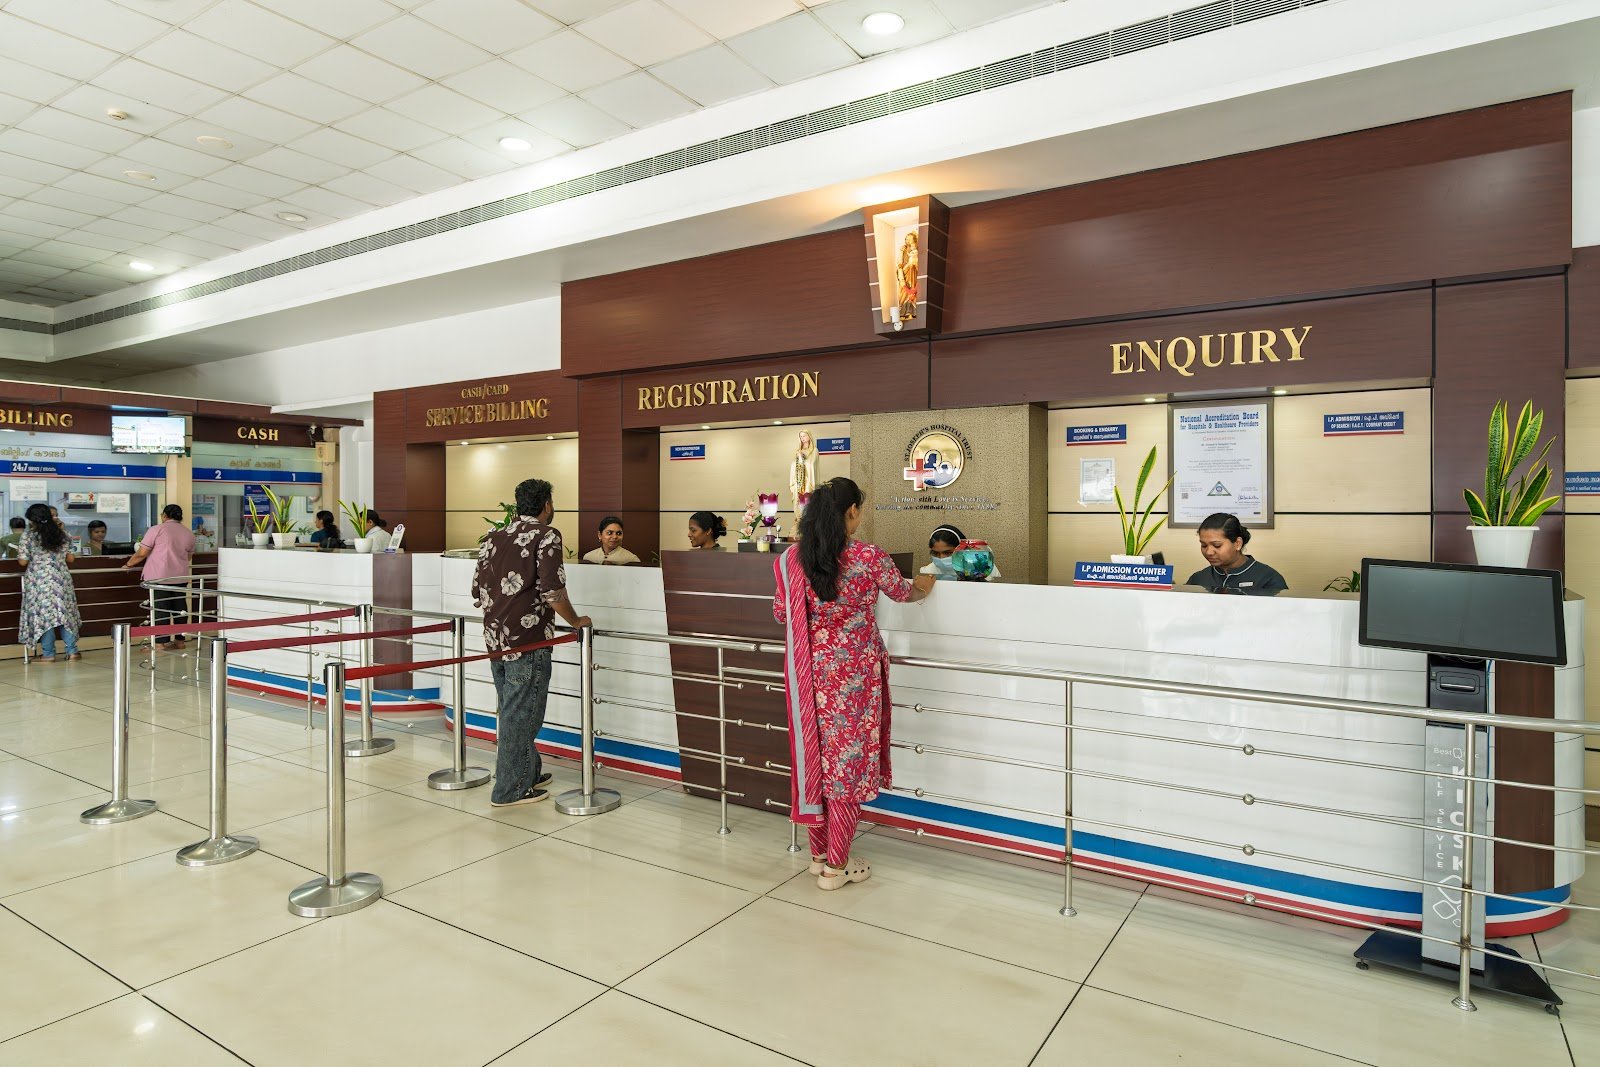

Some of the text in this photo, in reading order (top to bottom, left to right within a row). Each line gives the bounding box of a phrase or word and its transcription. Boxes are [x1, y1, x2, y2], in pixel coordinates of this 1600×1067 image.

[1110, 325, 1312, 376] ENQUIRY
[461, 383, 509, 399] CASH/CARD
[637, 371, 820, 410] REGISTRATION
[0, 408, 73, 428] BILLING
[426, 398, 548, 427] SERVICE BILLING
[1180, 412, 1259, 423] National Accreditation Board
[237, 426, 279, 441] CASH
[930, 423, 962, 439] HOSPITAL
[960, 436, 973, 461] TRUST
[122, 466, 127, 476] 1
[215, 470, 222, 480] 2
[291, 473, 296, 482] 1
[1092, 566, 1131, 574] ADMISSION
[1133, 567, 1167, 576] COUNTER
[1436, 808, 1445, 868] SEVICE
